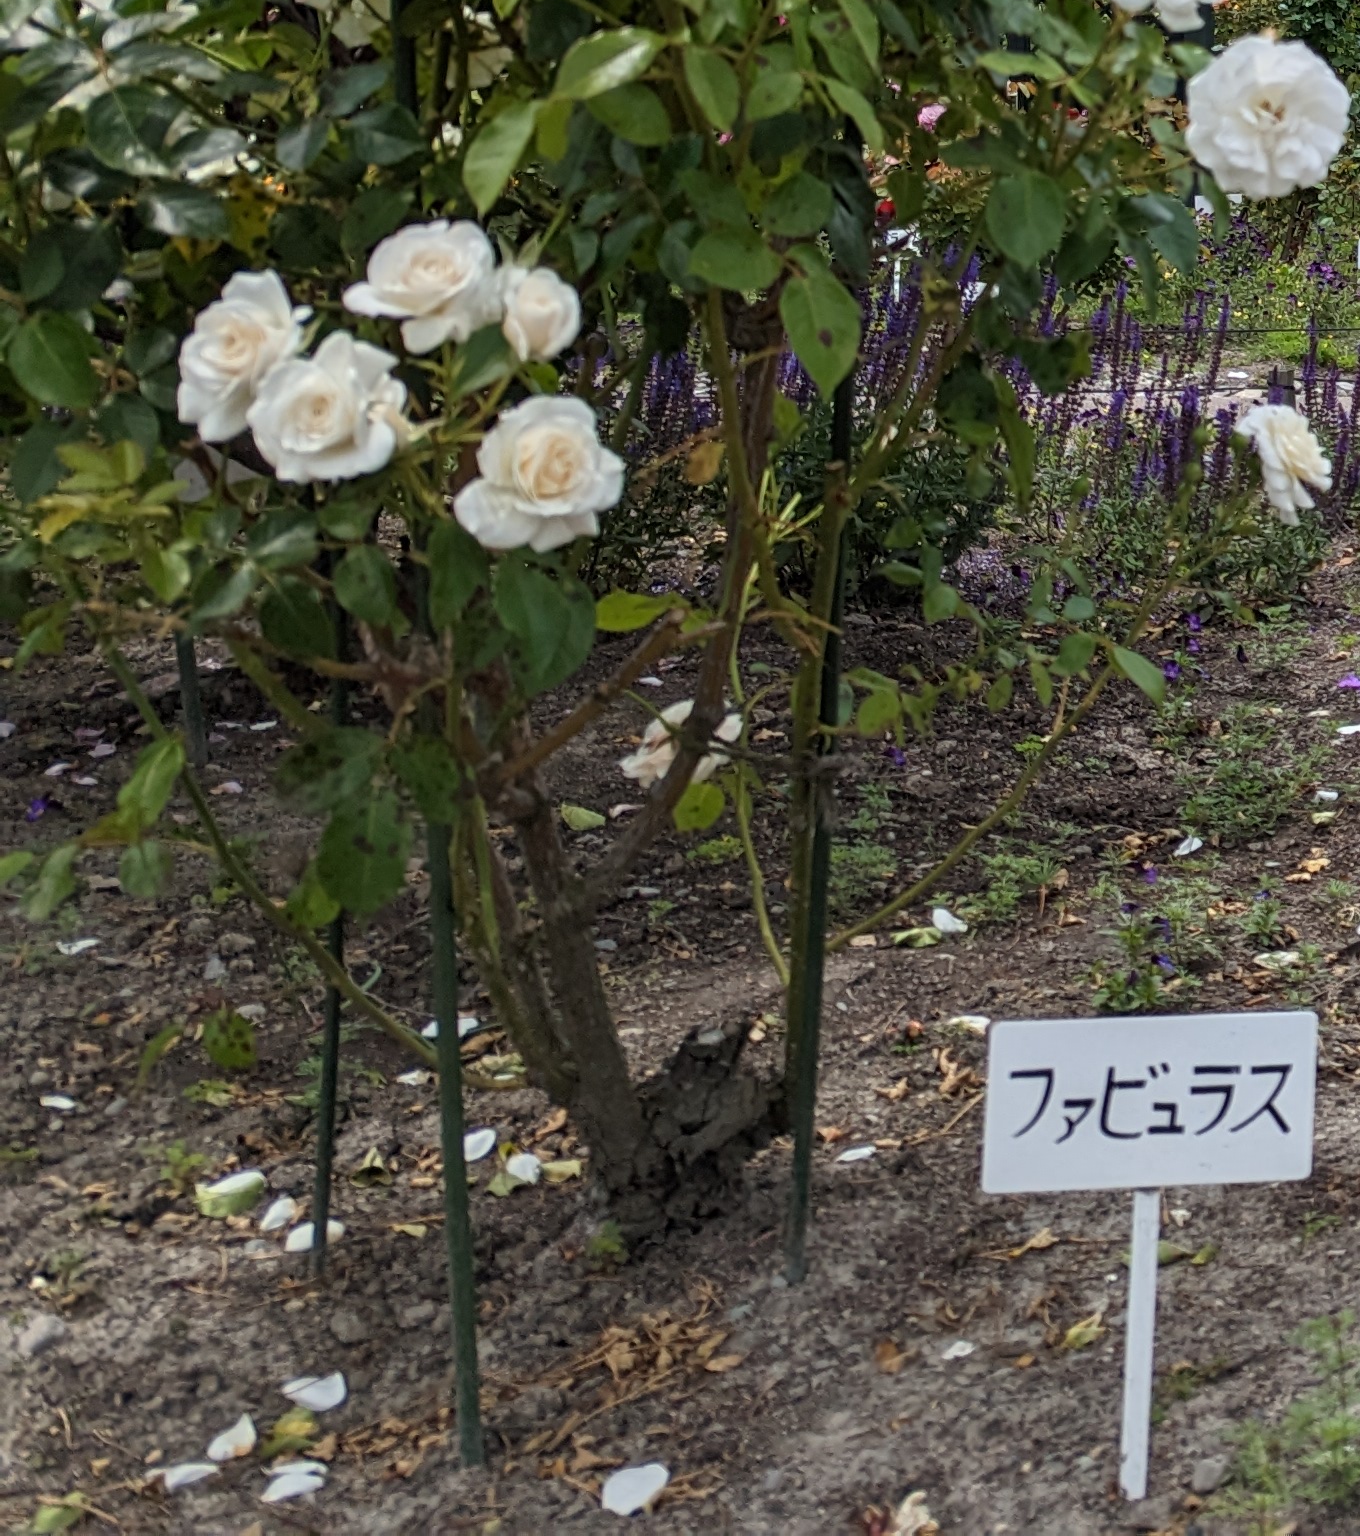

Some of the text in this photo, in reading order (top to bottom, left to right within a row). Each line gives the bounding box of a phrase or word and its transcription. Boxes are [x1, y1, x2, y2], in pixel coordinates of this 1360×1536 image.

[1009, 1062, 1294, 1145] ファビュラス
